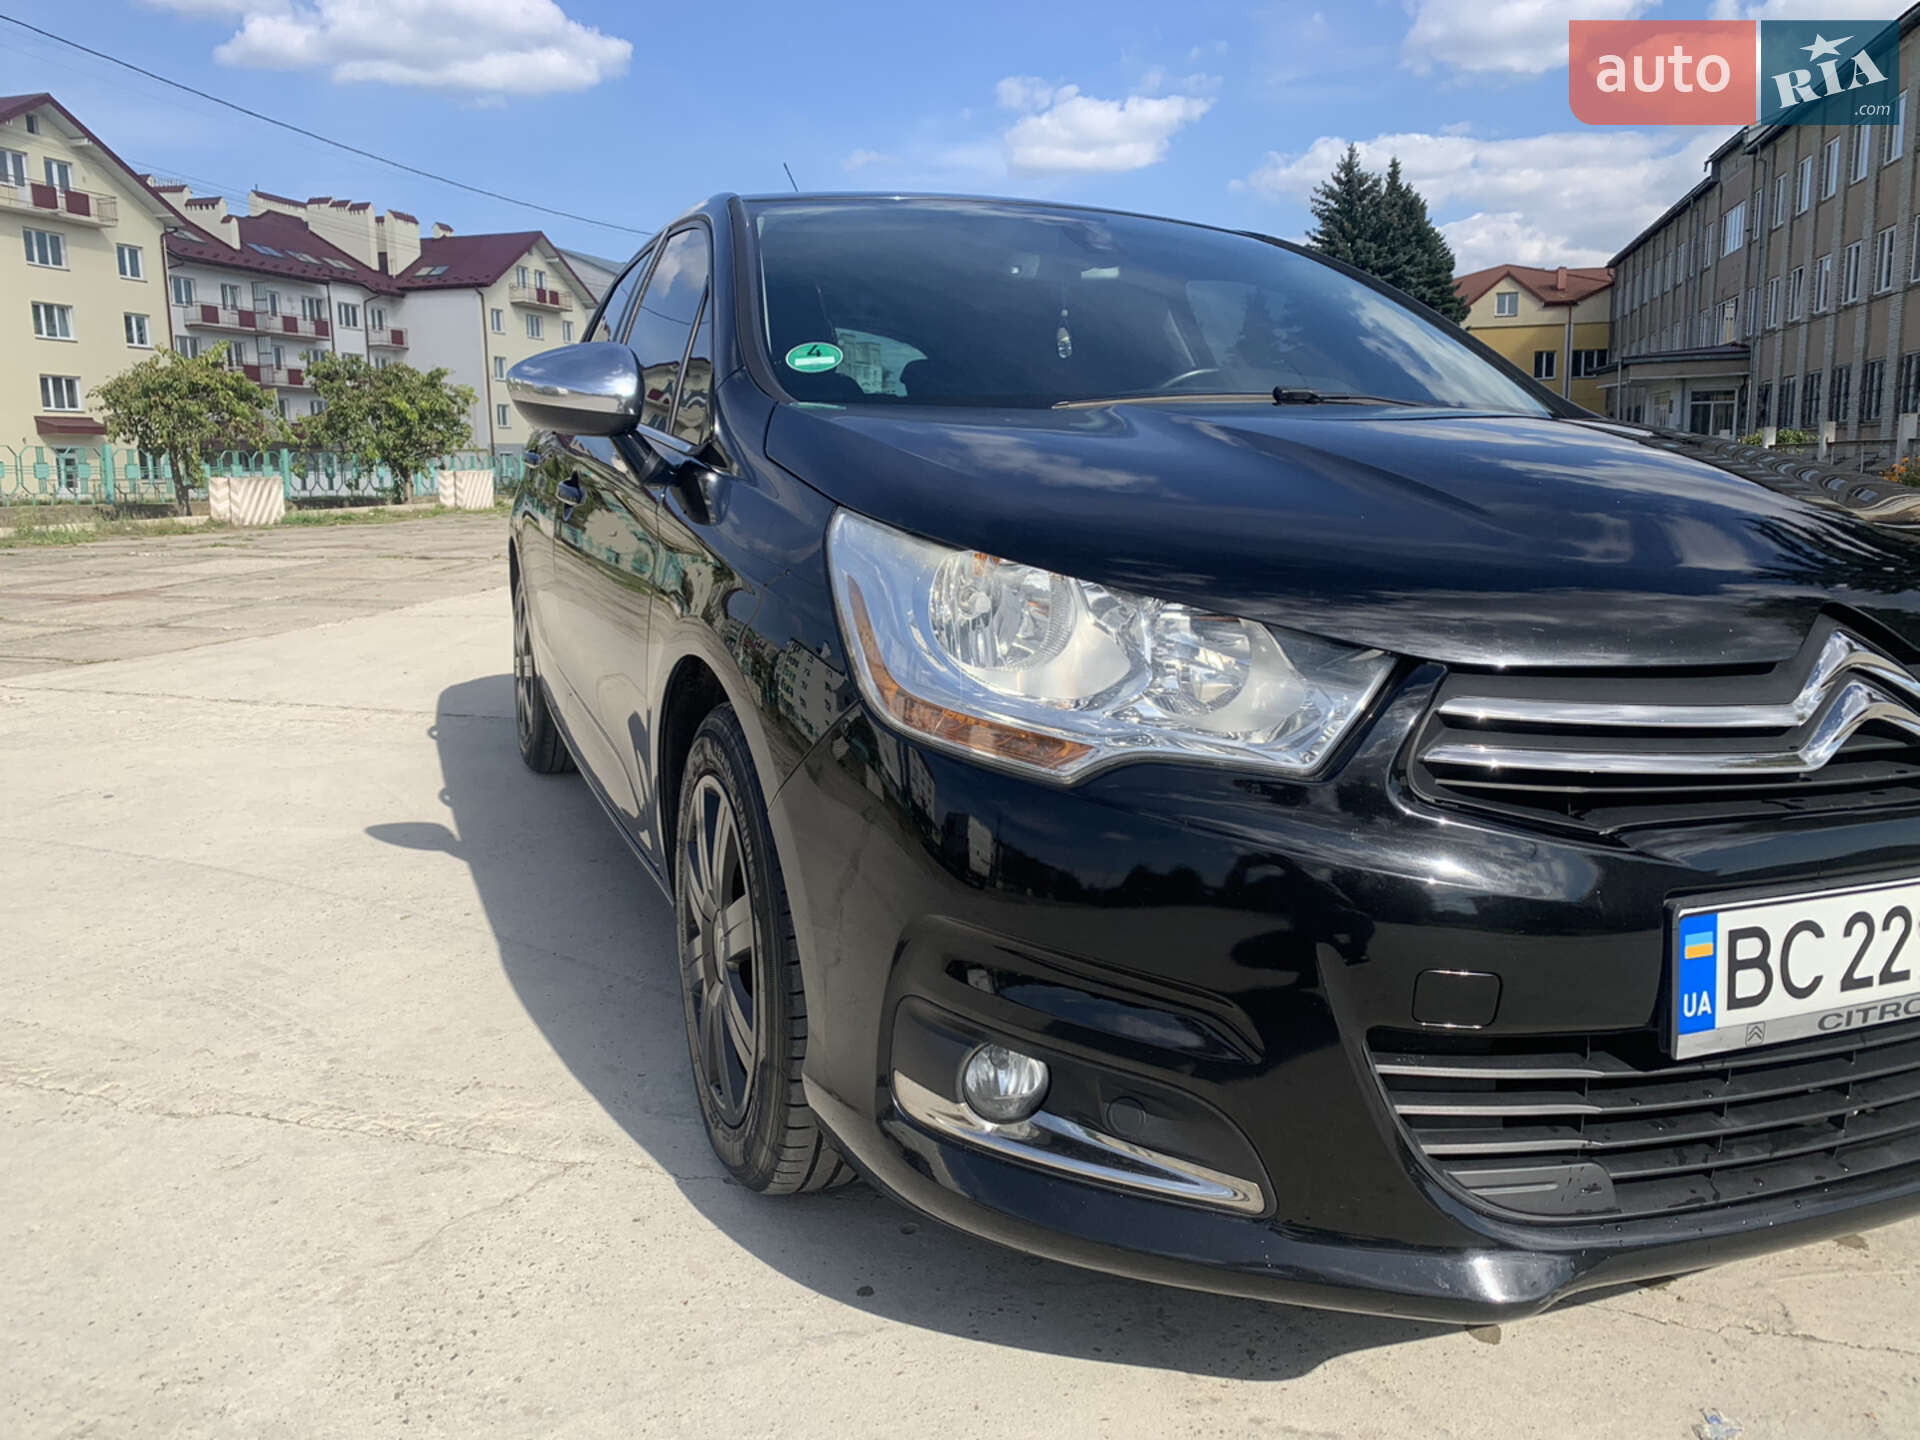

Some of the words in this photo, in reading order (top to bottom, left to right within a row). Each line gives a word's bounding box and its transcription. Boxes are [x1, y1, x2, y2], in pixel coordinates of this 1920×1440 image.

[807, 344, 821, 357] 4
[1726, 920, 1825, 1011] BC
[1840, 905, 1920, 993] 22
[1683, 990, 1712, 1018] UA
